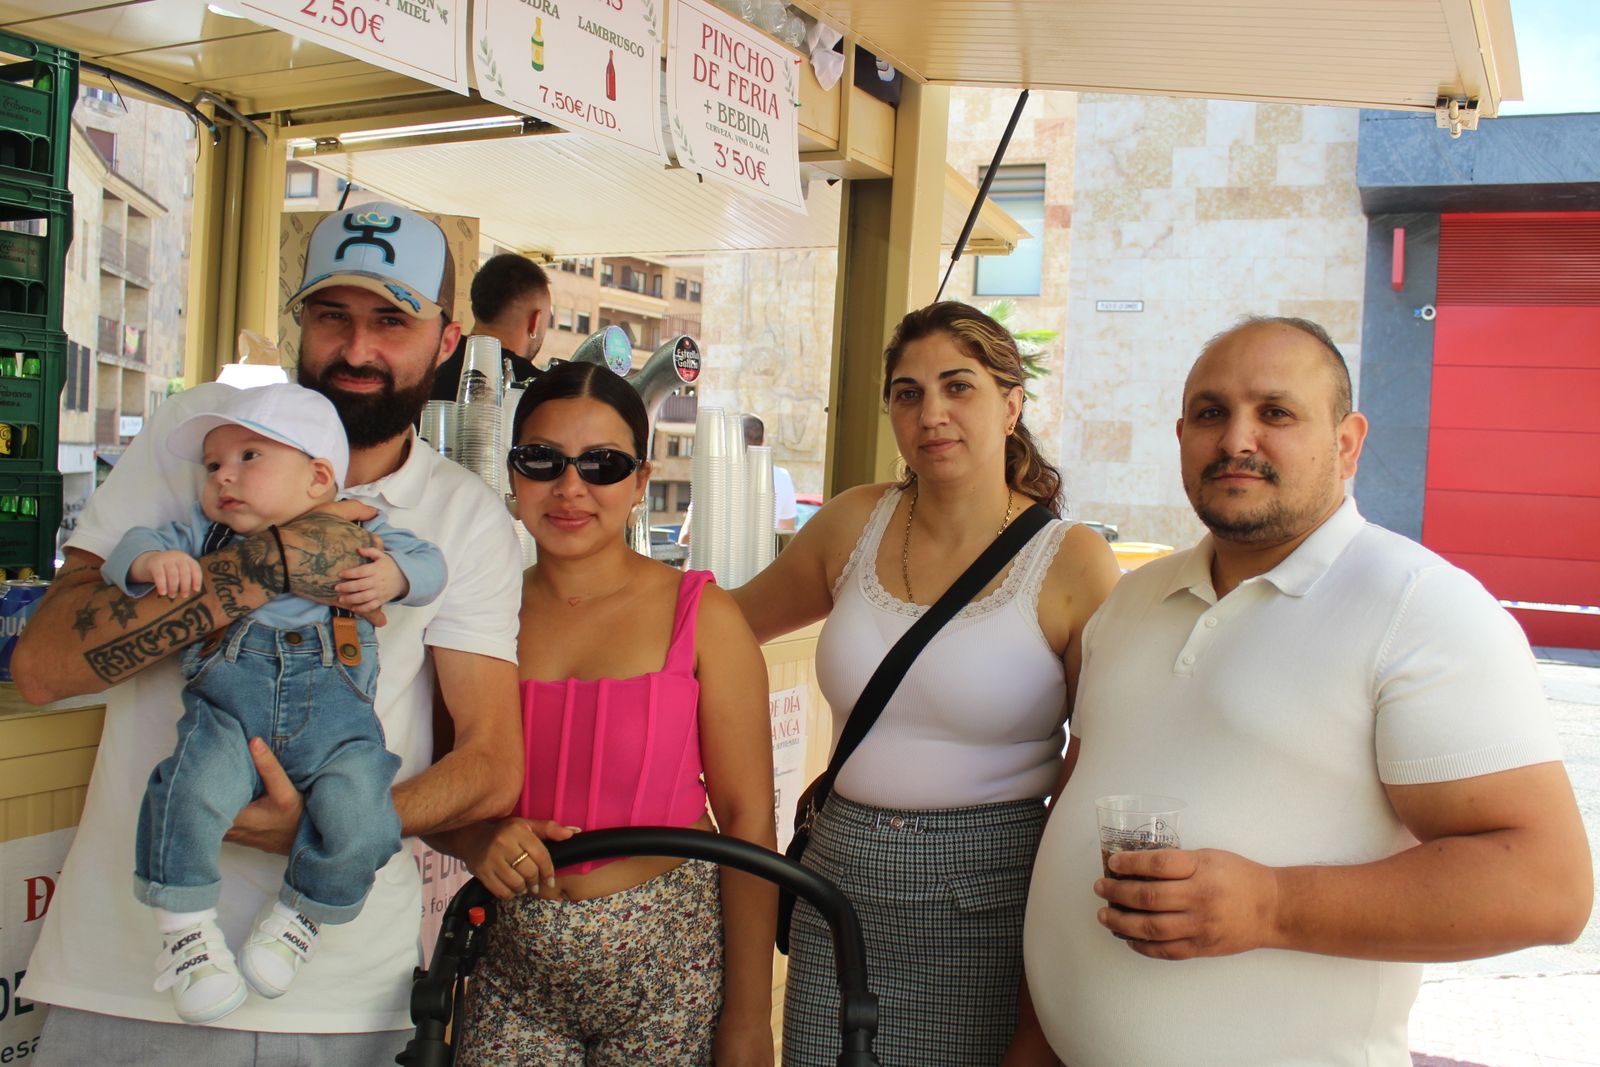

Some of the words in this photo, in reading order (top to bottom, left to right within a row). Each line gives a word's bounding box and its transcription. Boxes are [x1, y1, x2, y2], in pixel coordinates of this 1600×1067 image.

[397, 0, 430, 23] MIEL
[519, 0, 561, 19] IDRA
[577, 16, 645, 58] LAMBRUSCO
[701, 23, 775, 83] PINCHO
[692, 53, 721, 91] DE
[727, 71, 780, 120] FERIA
[539, 85, 622, 132] 7,50€/UD.
[704, 99, 712, 114] +
[717, 101, 771, 144] BEBIDA
[171, 930, 203, 955] MICKEY
[176, 952, 210, 976] MOUSE
